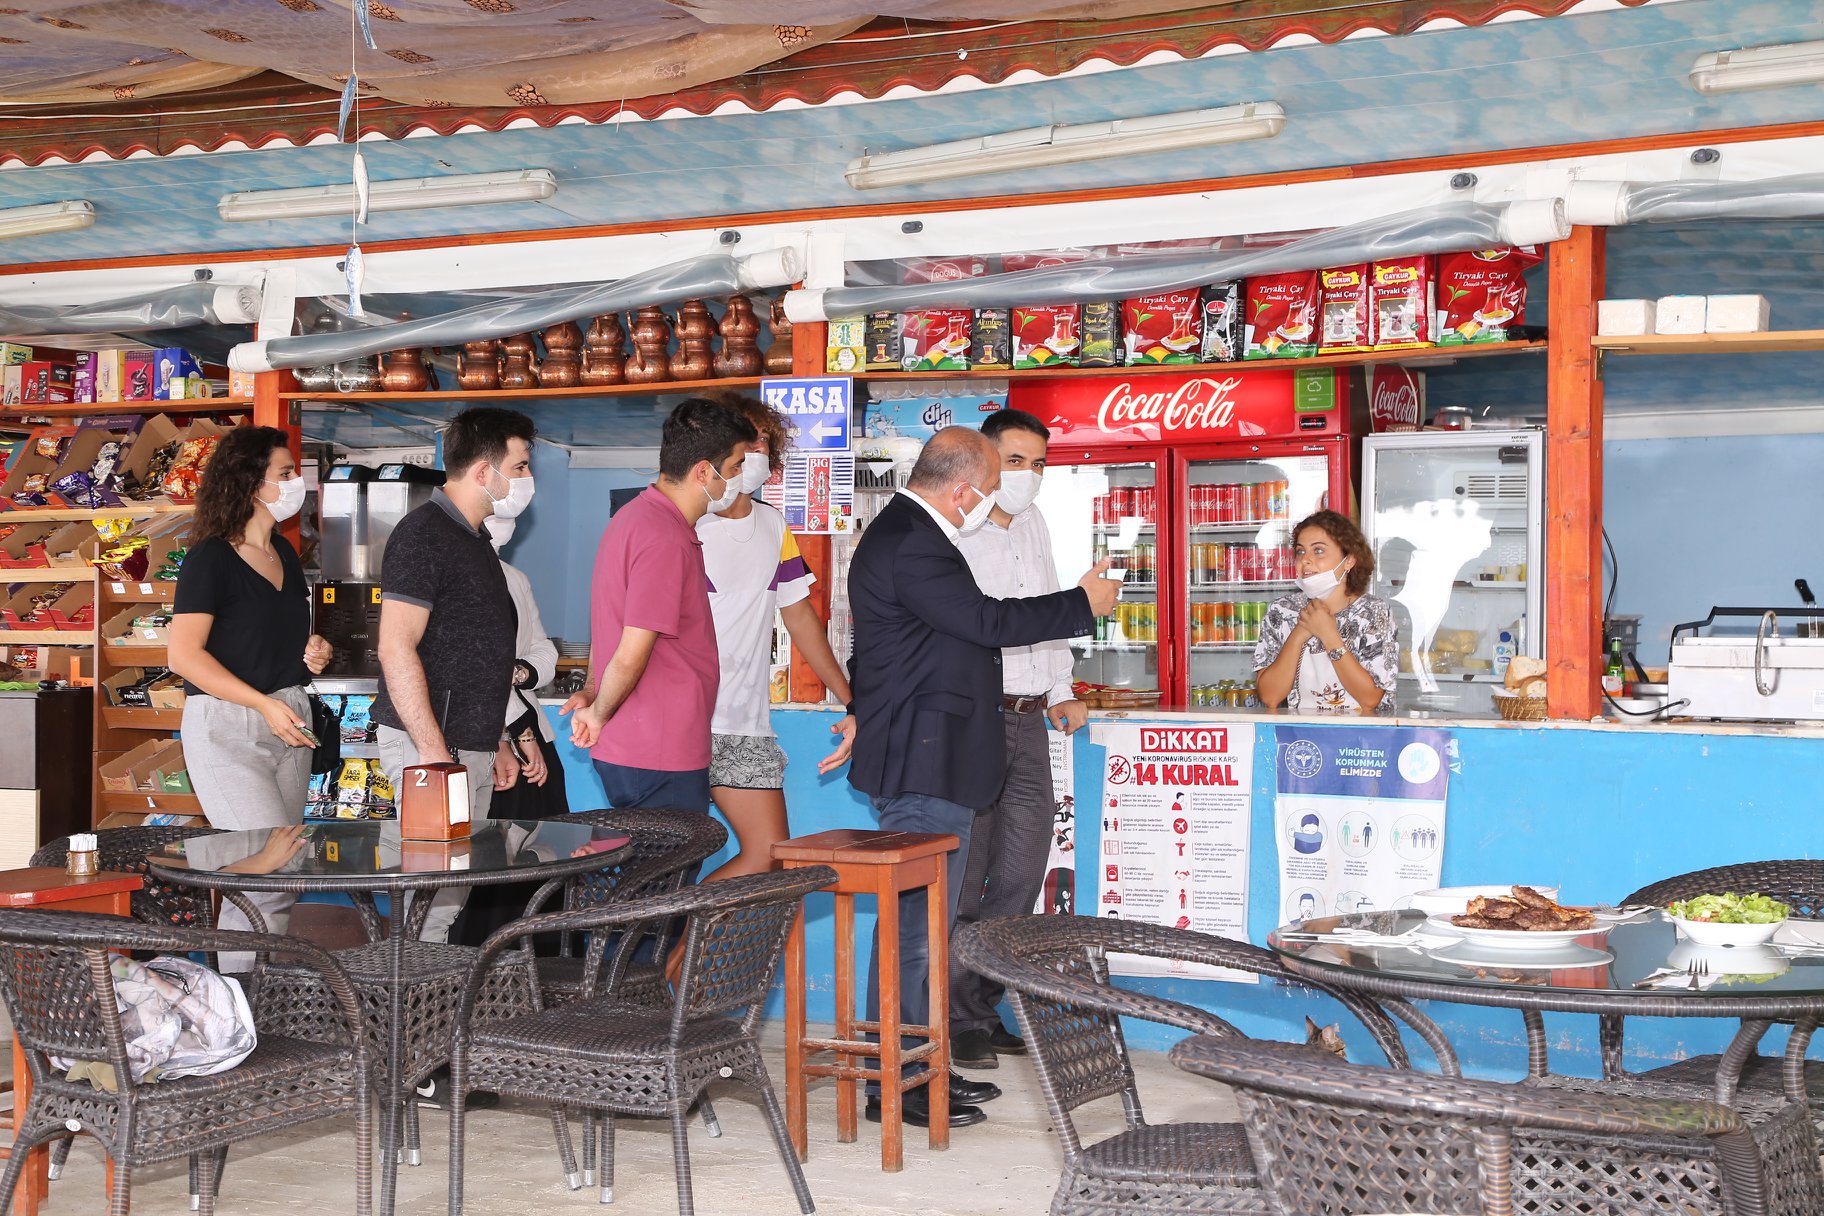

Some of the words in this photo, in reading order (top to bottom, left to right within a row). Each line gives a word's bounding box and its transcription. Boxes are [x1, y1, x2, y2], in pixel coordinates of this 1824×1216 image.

[1453, 271, 1485, 281] Tiryaki
[1259, 285, 1287, 295] Tiryaki
[1289, 285, 1305, 294] Çay
[1378, 288, 1400, 296] Tiryaki
[1170, 294, 1189, 304] Çayı
[765, 386, 846, 415] KASA
[1097, 376, 1244, 434] Coca-Cola
[1374, 381, 1419, 423] Coca-Cola
[810, 458, 829, 469] BIG
[123, 693, 144, 701] negro
[1338, 748, 1385, 758] VİRÜSTEN
[1335, 758, 1388, 768] KORUNMAK
[1162, 764, 1239, 786] KURAL
[1340, 767, 1382, 778] ELİMİZDE
[414, 769, 429, 787] 2
